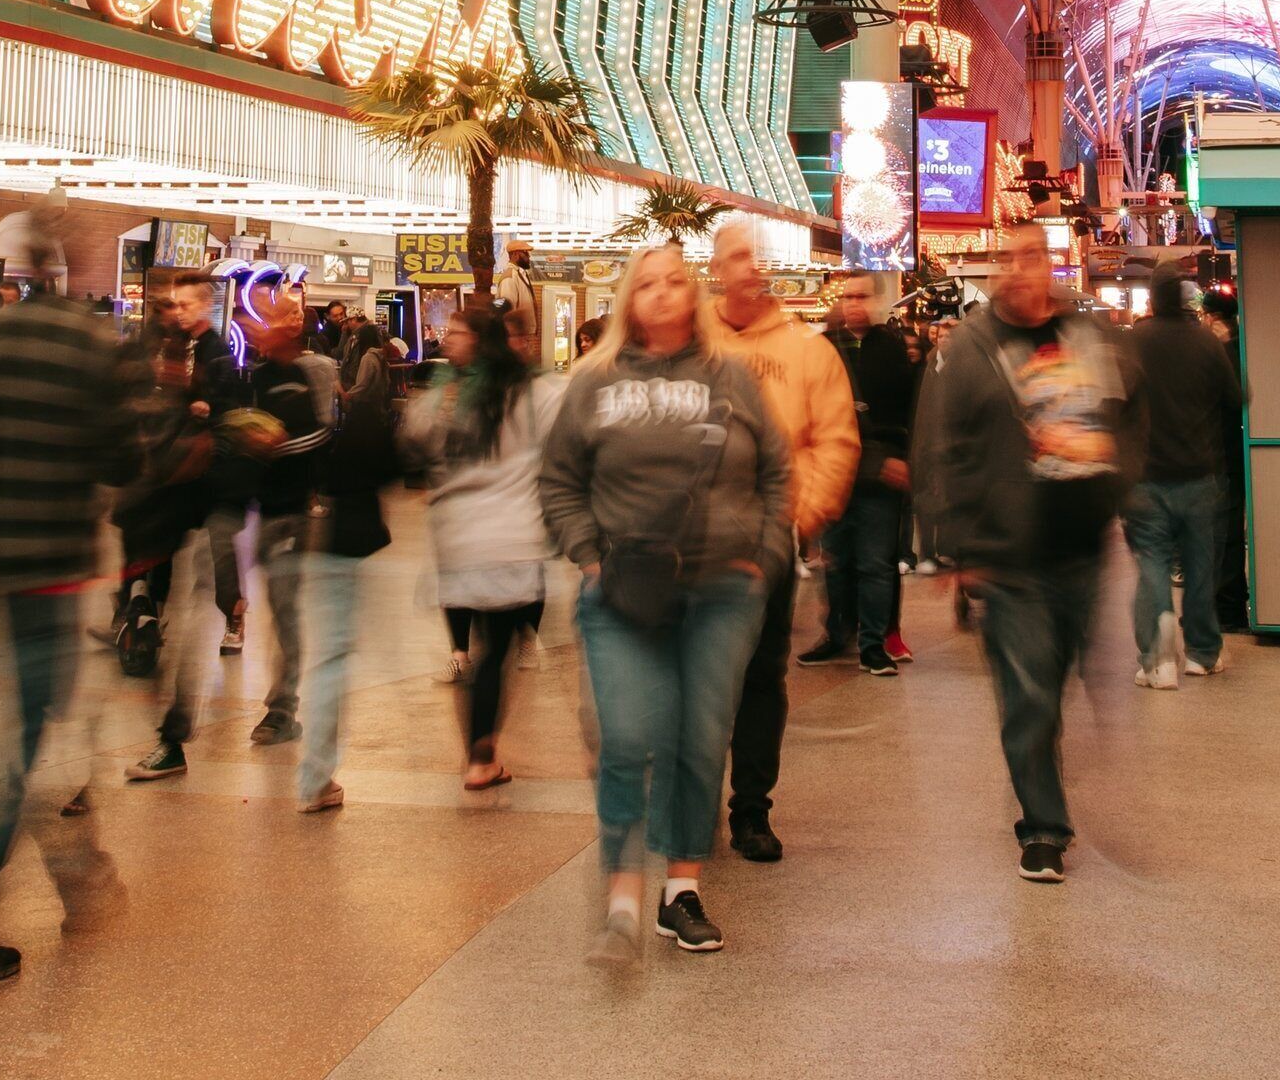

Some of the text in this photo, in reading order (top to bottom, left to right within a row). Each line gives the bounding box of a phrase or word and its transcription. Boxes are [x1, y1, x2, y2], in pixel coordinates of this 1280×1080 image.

[926, 139, 950, 161] $3
[918, 161, 972, 176] eineken
[176, 224, 207, 245] FISH
[399, 234, 468, 253] FISH
[176, 246, 200, 266] SPA
[404, 254, 464, 272] SPA
[752, 353, 789, 386] ORK
